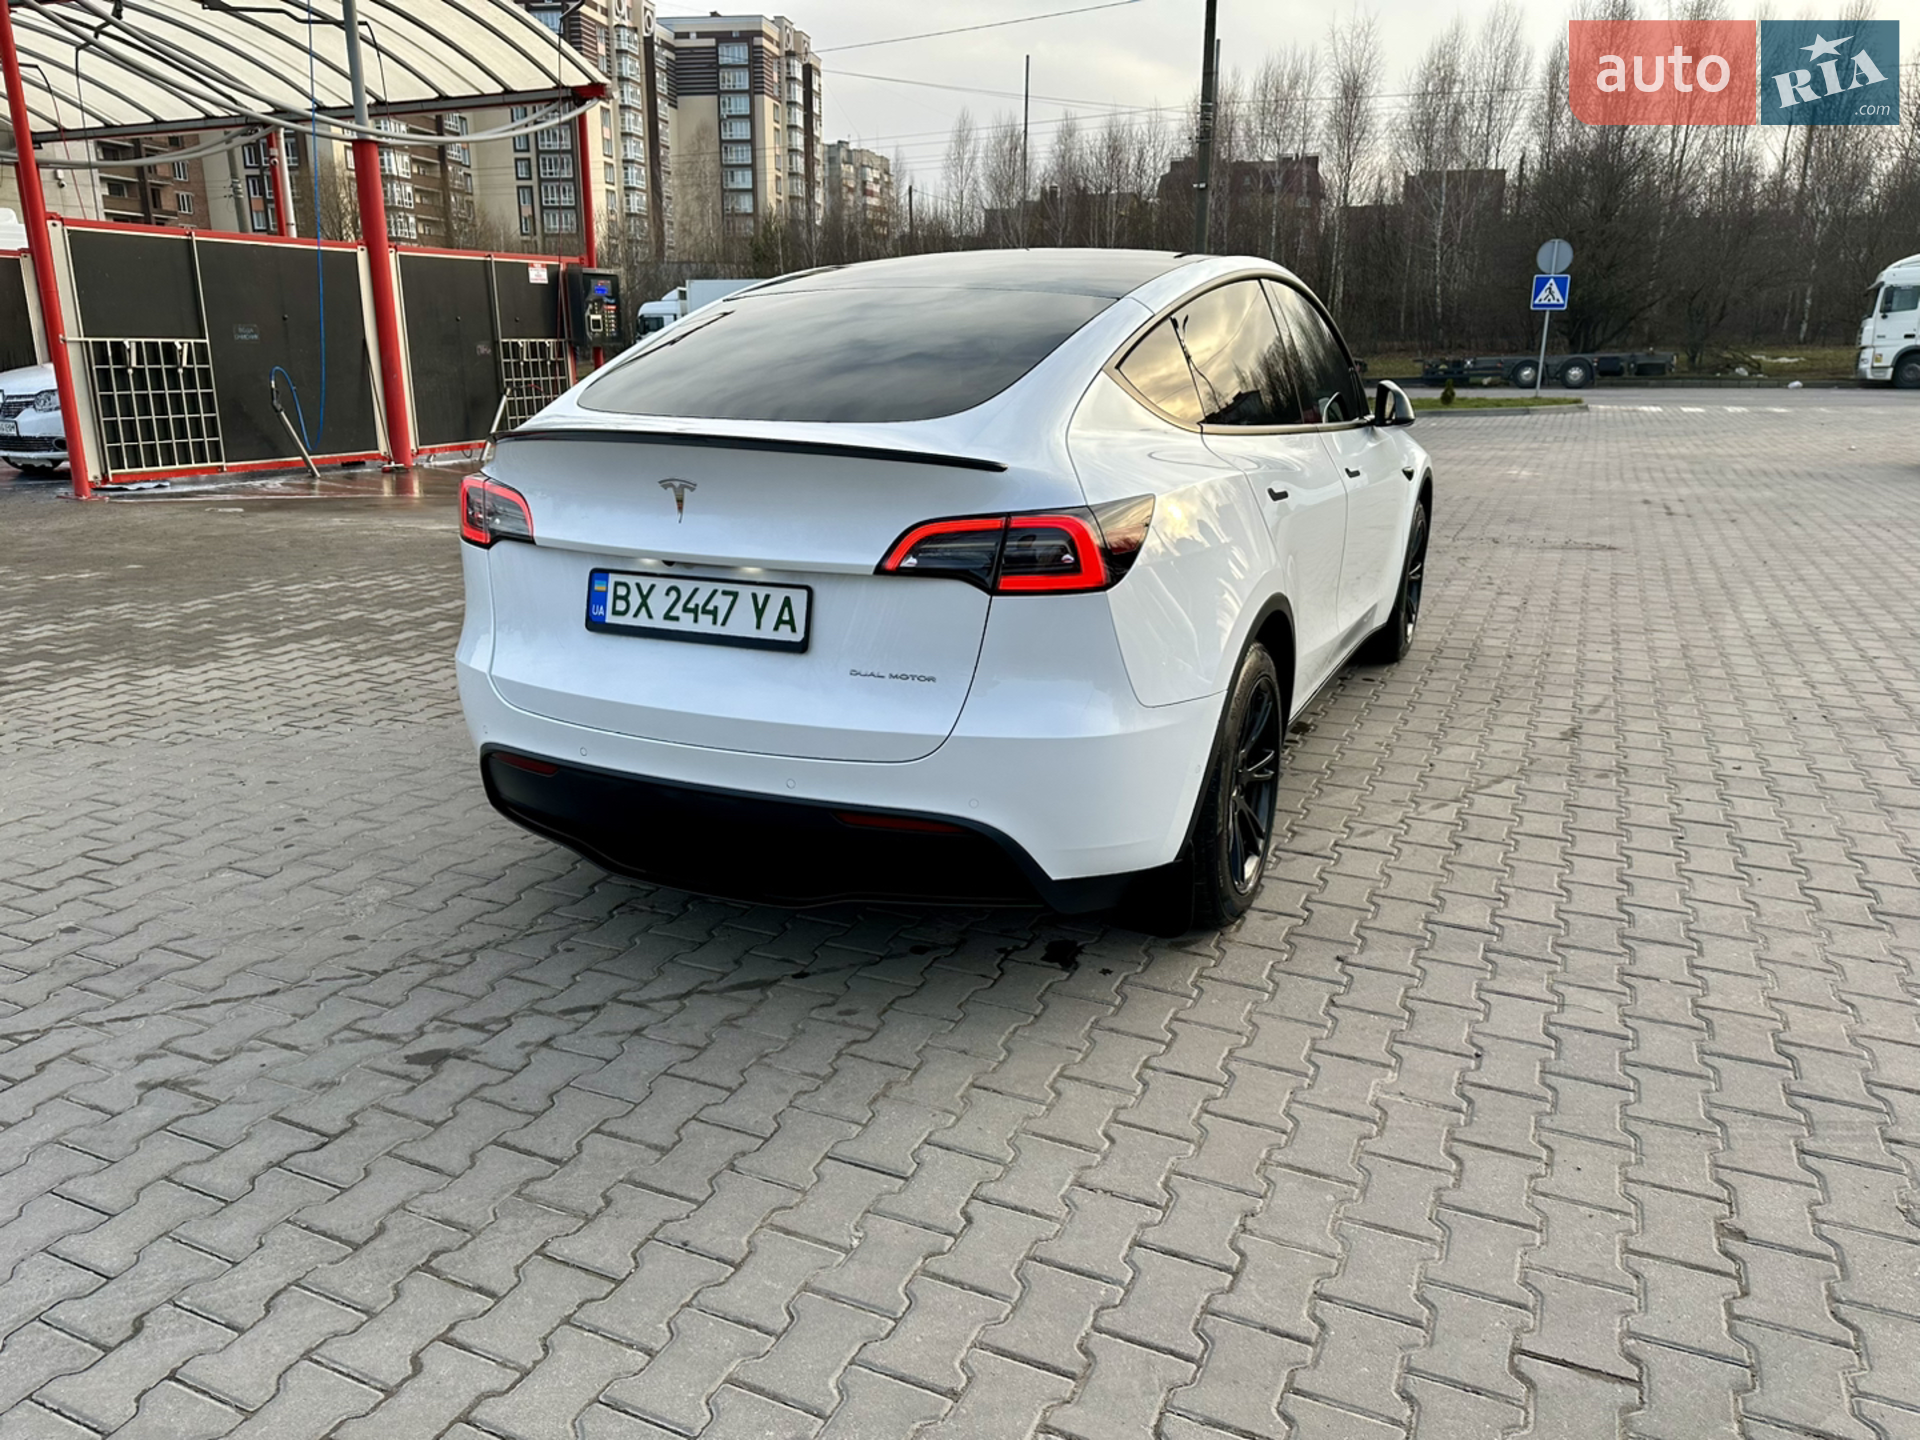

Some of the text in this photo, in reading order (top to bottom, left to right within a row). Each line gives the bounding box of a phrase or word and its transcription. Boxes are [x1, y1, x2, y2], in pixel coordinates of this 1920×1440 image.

[591, 604, 605, 616] UA
[611, 580, 797, 633] BX 2447 YA
[849, 669, 937, 683] DUAL MOTOR
